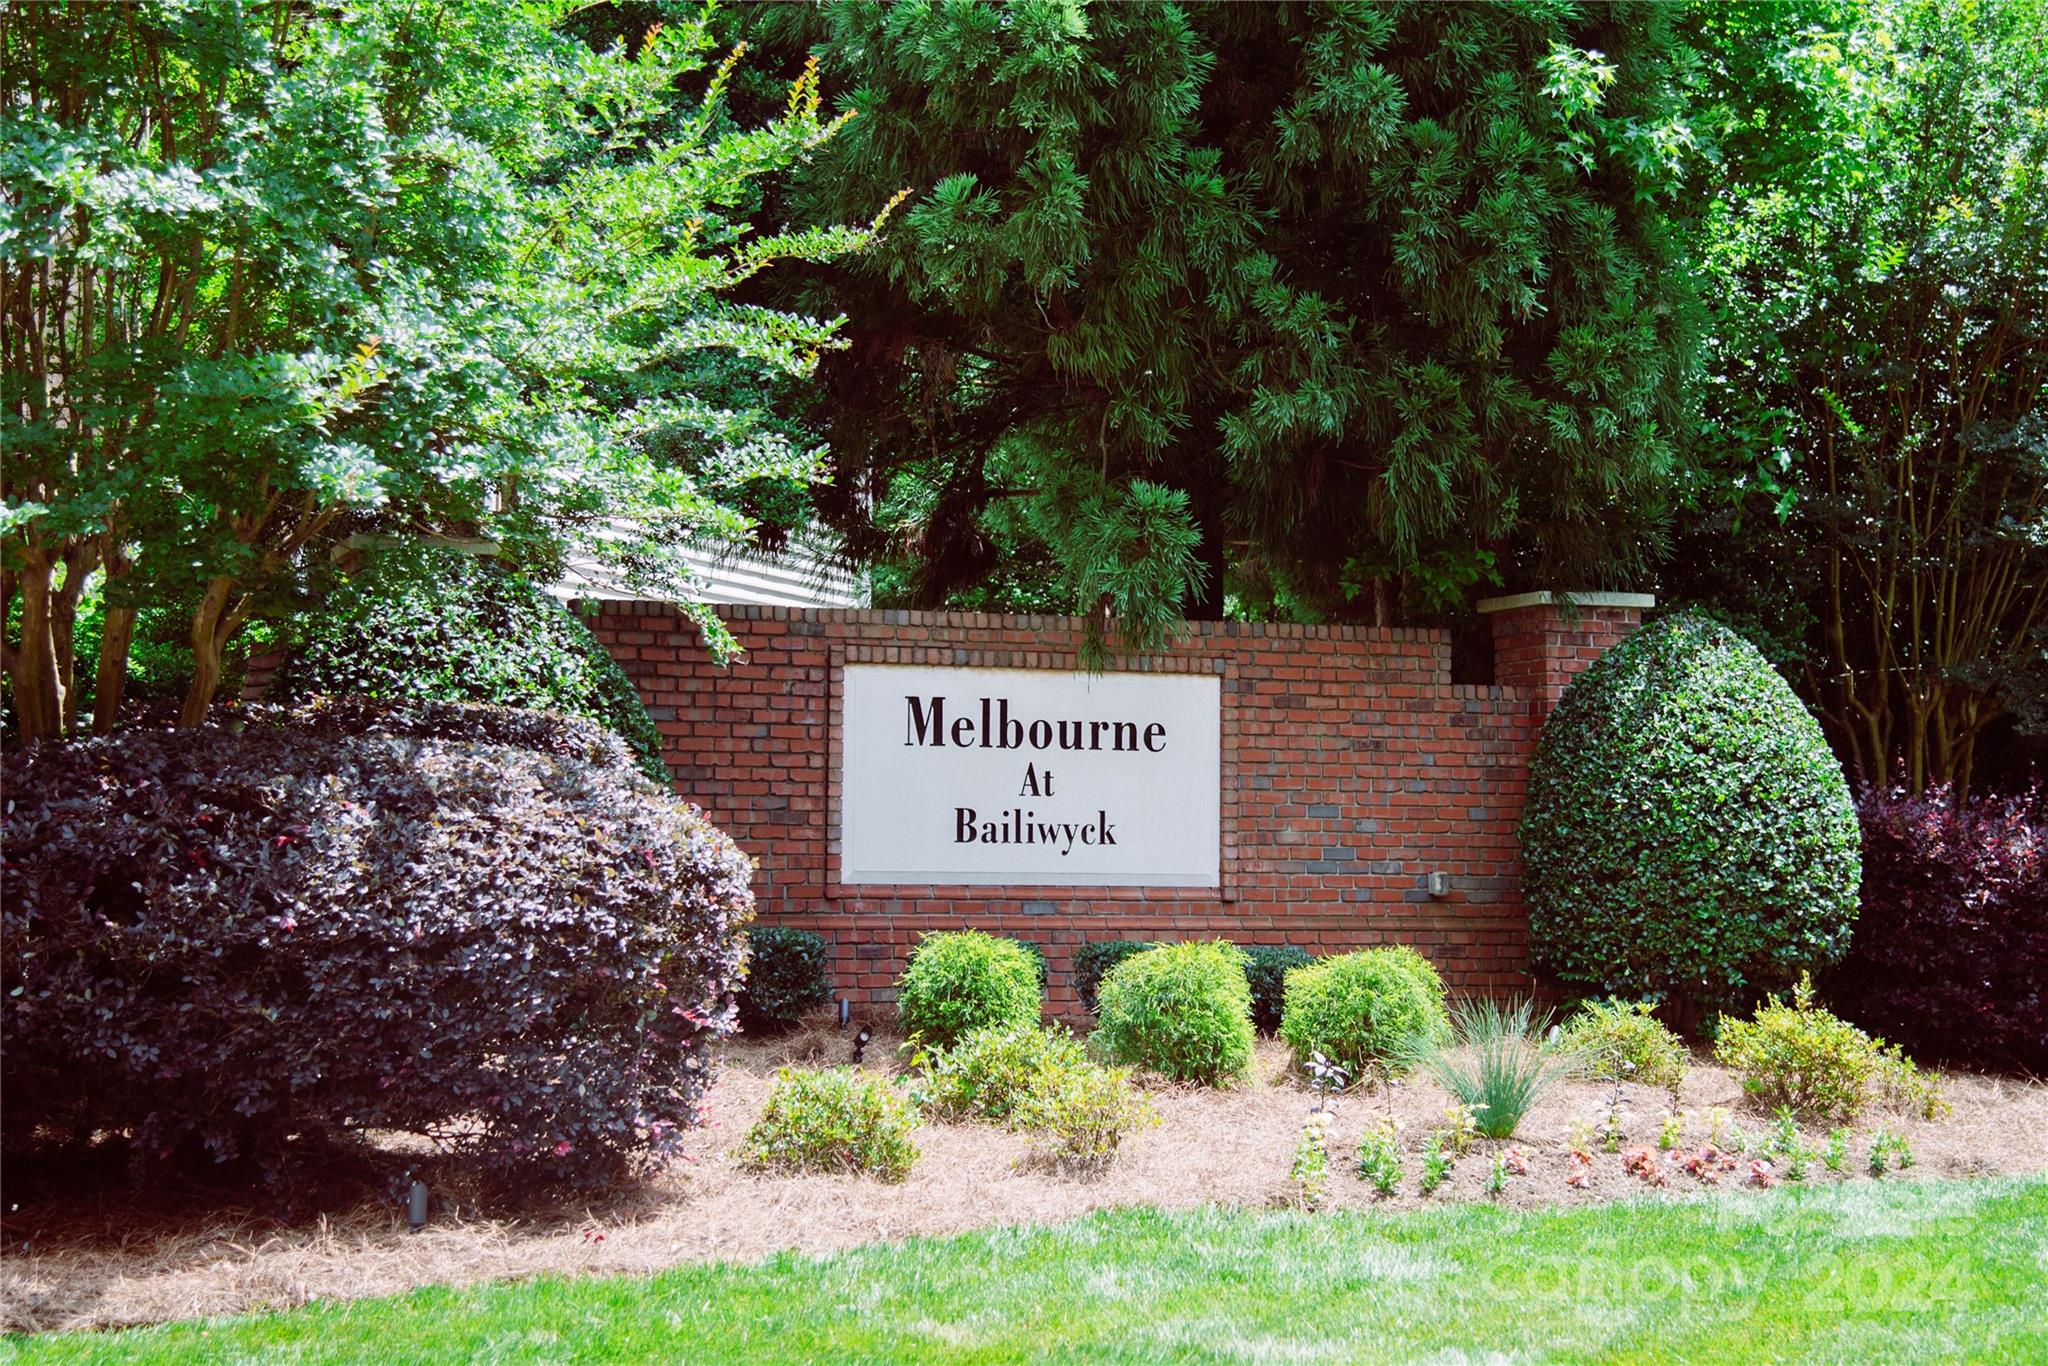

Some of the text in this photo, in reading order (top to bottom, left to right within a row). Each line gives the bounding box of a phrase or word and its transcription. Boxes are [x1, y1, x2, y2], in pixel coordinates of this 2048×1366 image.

[904, 695, 1167, 753] Melbourne
[1018, 761, 1056, 797] At
[953, 807, 1118, 857] Bailiwyck
